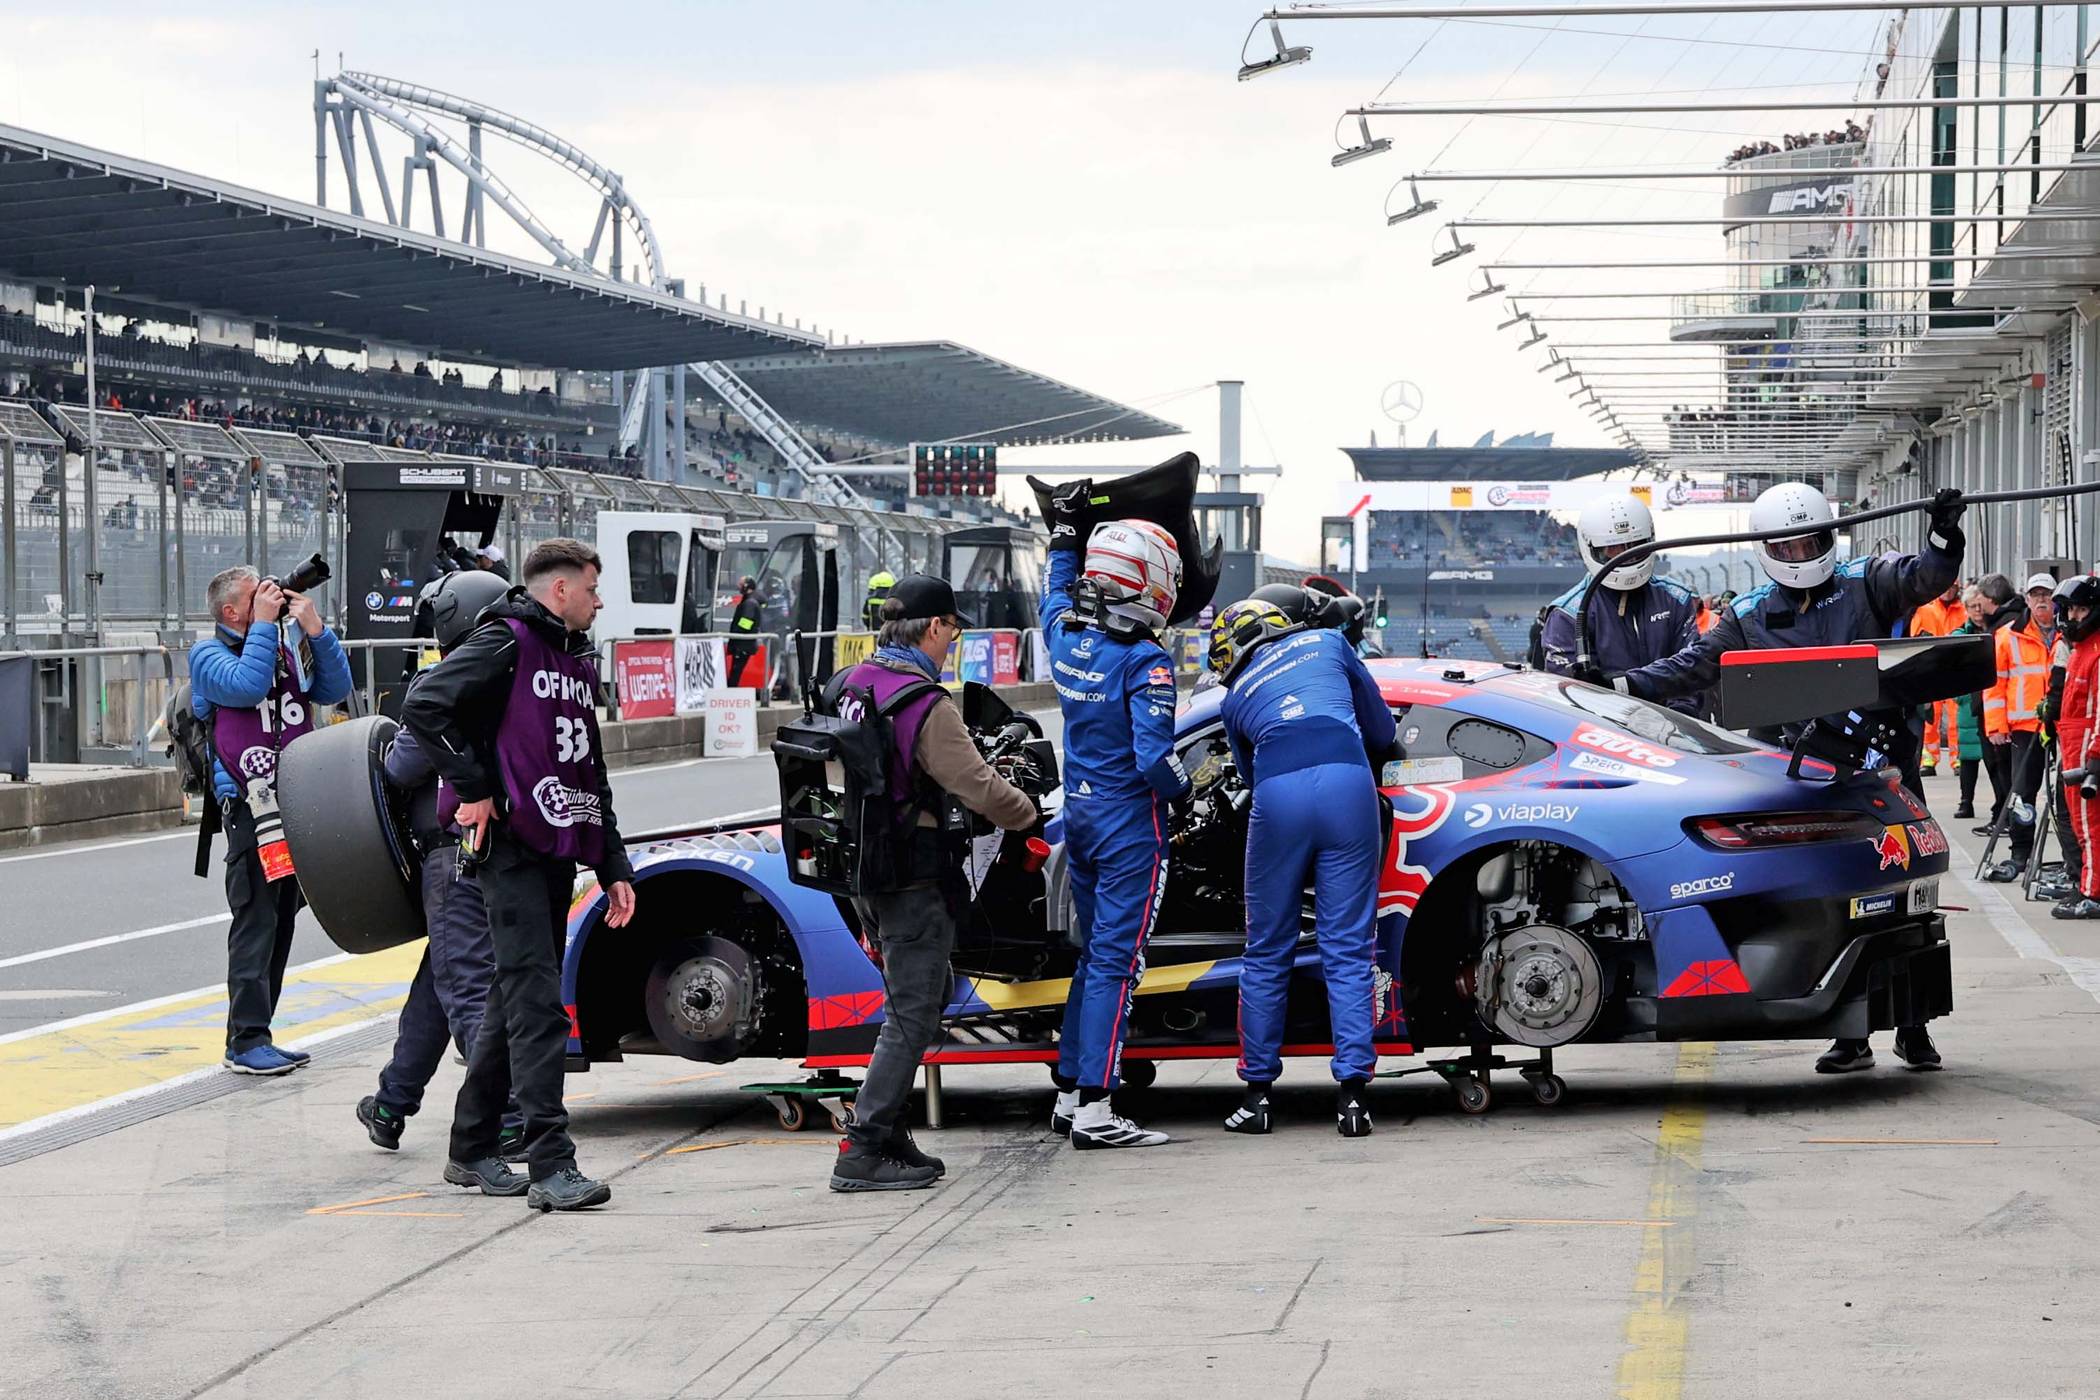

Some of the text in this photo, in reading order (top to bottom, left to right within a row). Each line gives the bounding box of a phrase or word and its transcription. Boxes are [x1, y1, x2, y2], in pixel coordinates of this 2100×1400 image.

[399, 468, 466, 476] SCHUBERT
[1630, 486, 1651, 494] ADAC
[1790, 511, 1808, 522] OMP
[1614, 522, 1630, 531] OMP
[726, 533, 769, 543] GT3
[1453, 571, 1494, 581] AMG
[369, 614, 410, 623] Motorsport
[710, 699, 751, 709] DRIVER
[724, 712, 736, 720] ID
[718, 724, 741, 734] OK?
[555, 715, 590, 764] 33
[1577, 732, 1677, 768] auto
[1497, 803, 1580, 823] viaplay
[1670, 874, 1733, 898] sparco
[1865, 899, 1892, 911] MICHELIN
